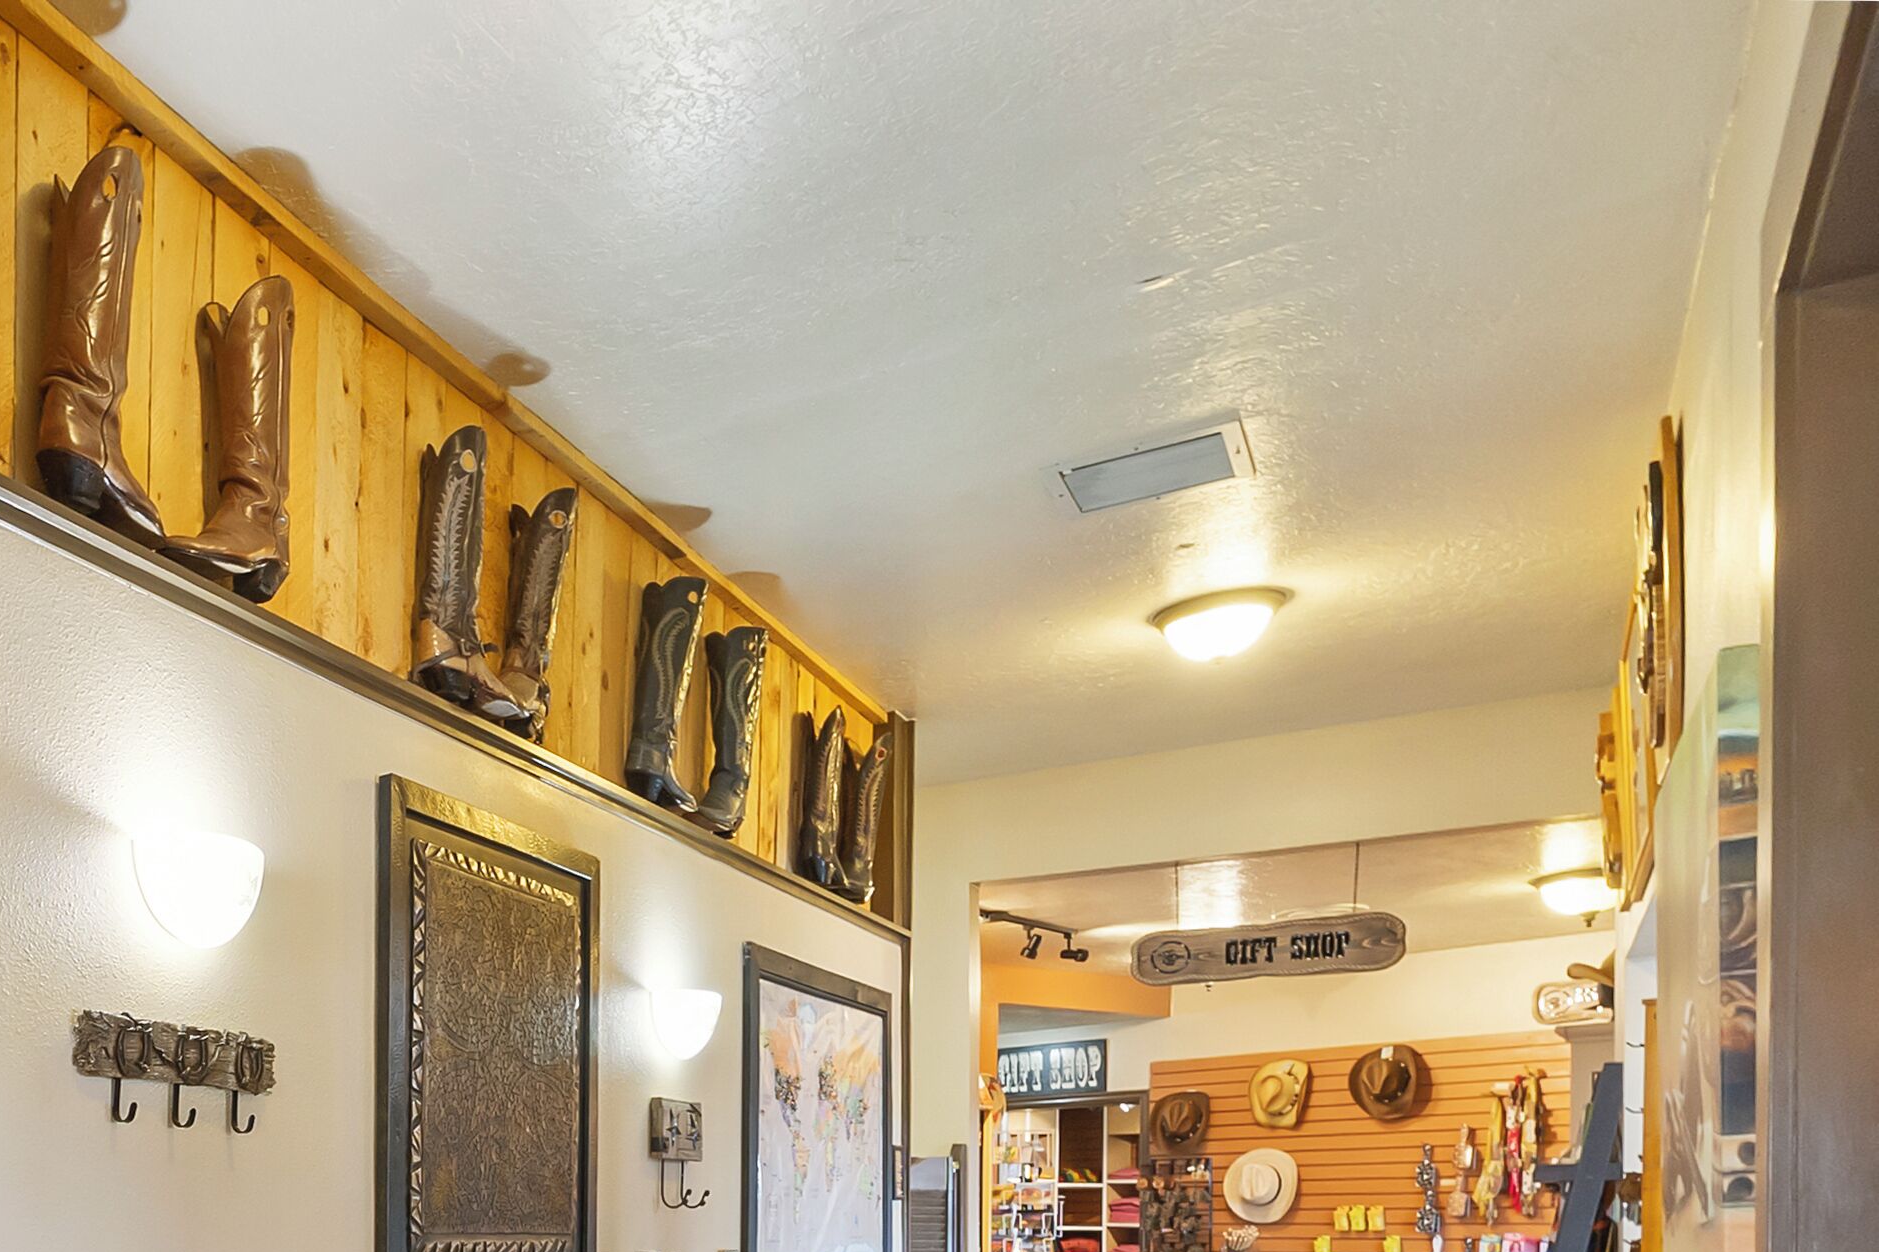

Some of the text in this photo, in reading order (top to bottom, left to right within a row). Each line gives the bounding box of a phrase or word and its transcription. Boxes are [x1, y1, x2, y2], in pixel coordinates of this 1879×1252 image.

[1225, 930, 1350, 966] GIFT SHOP
[998, 1045, 1101, 1093] GIFT SHOP
